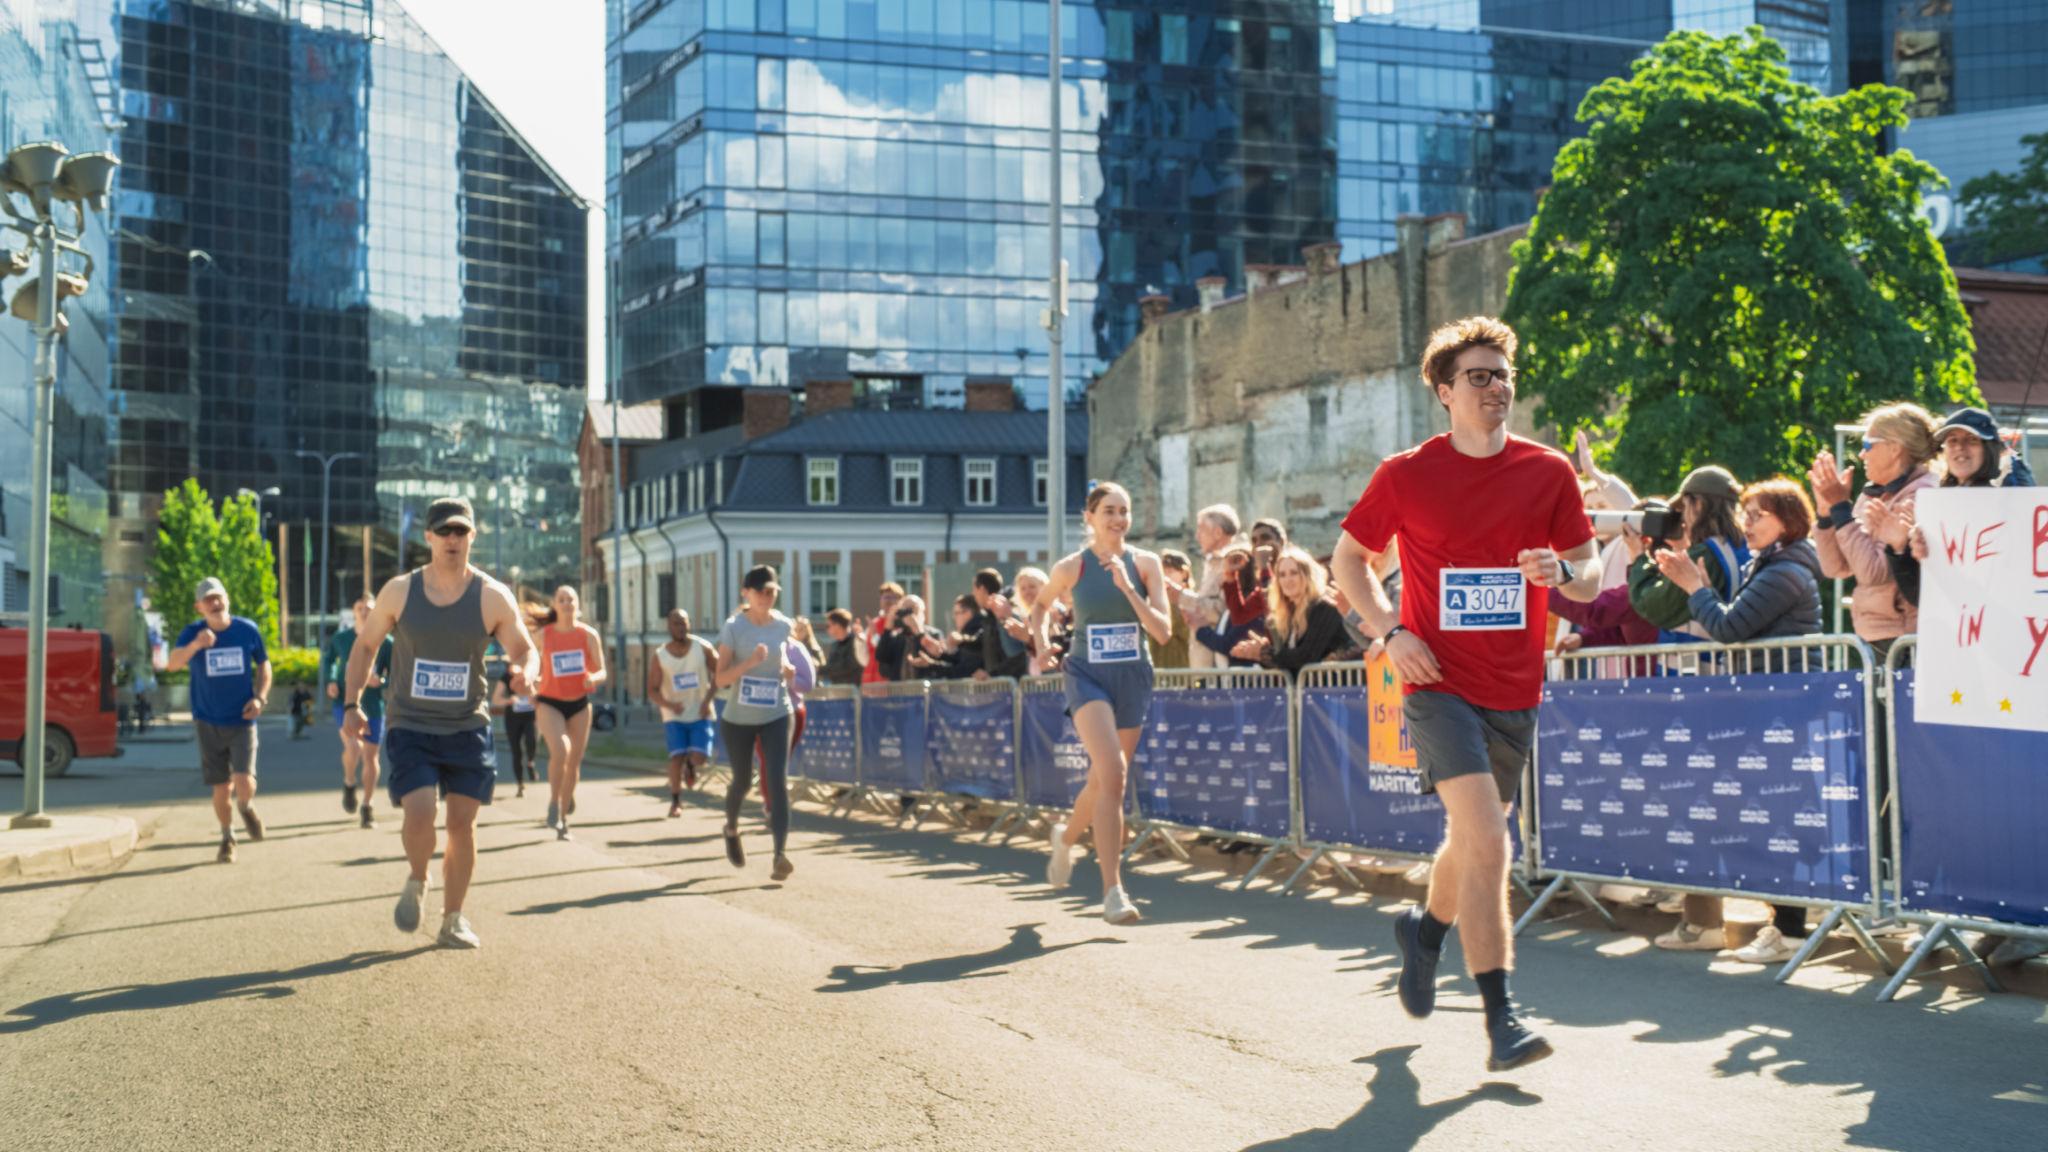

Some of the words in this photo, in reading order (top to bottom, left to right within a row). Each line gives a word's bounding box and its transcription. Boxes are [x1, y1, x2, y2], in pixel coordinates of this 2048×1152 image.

[1940, 521, 2007, 564] WE
[1449, 593, 1463, 608] A
[1471, 588, 1520, 610] 3047
[432, 673, 464, 690] 2159
